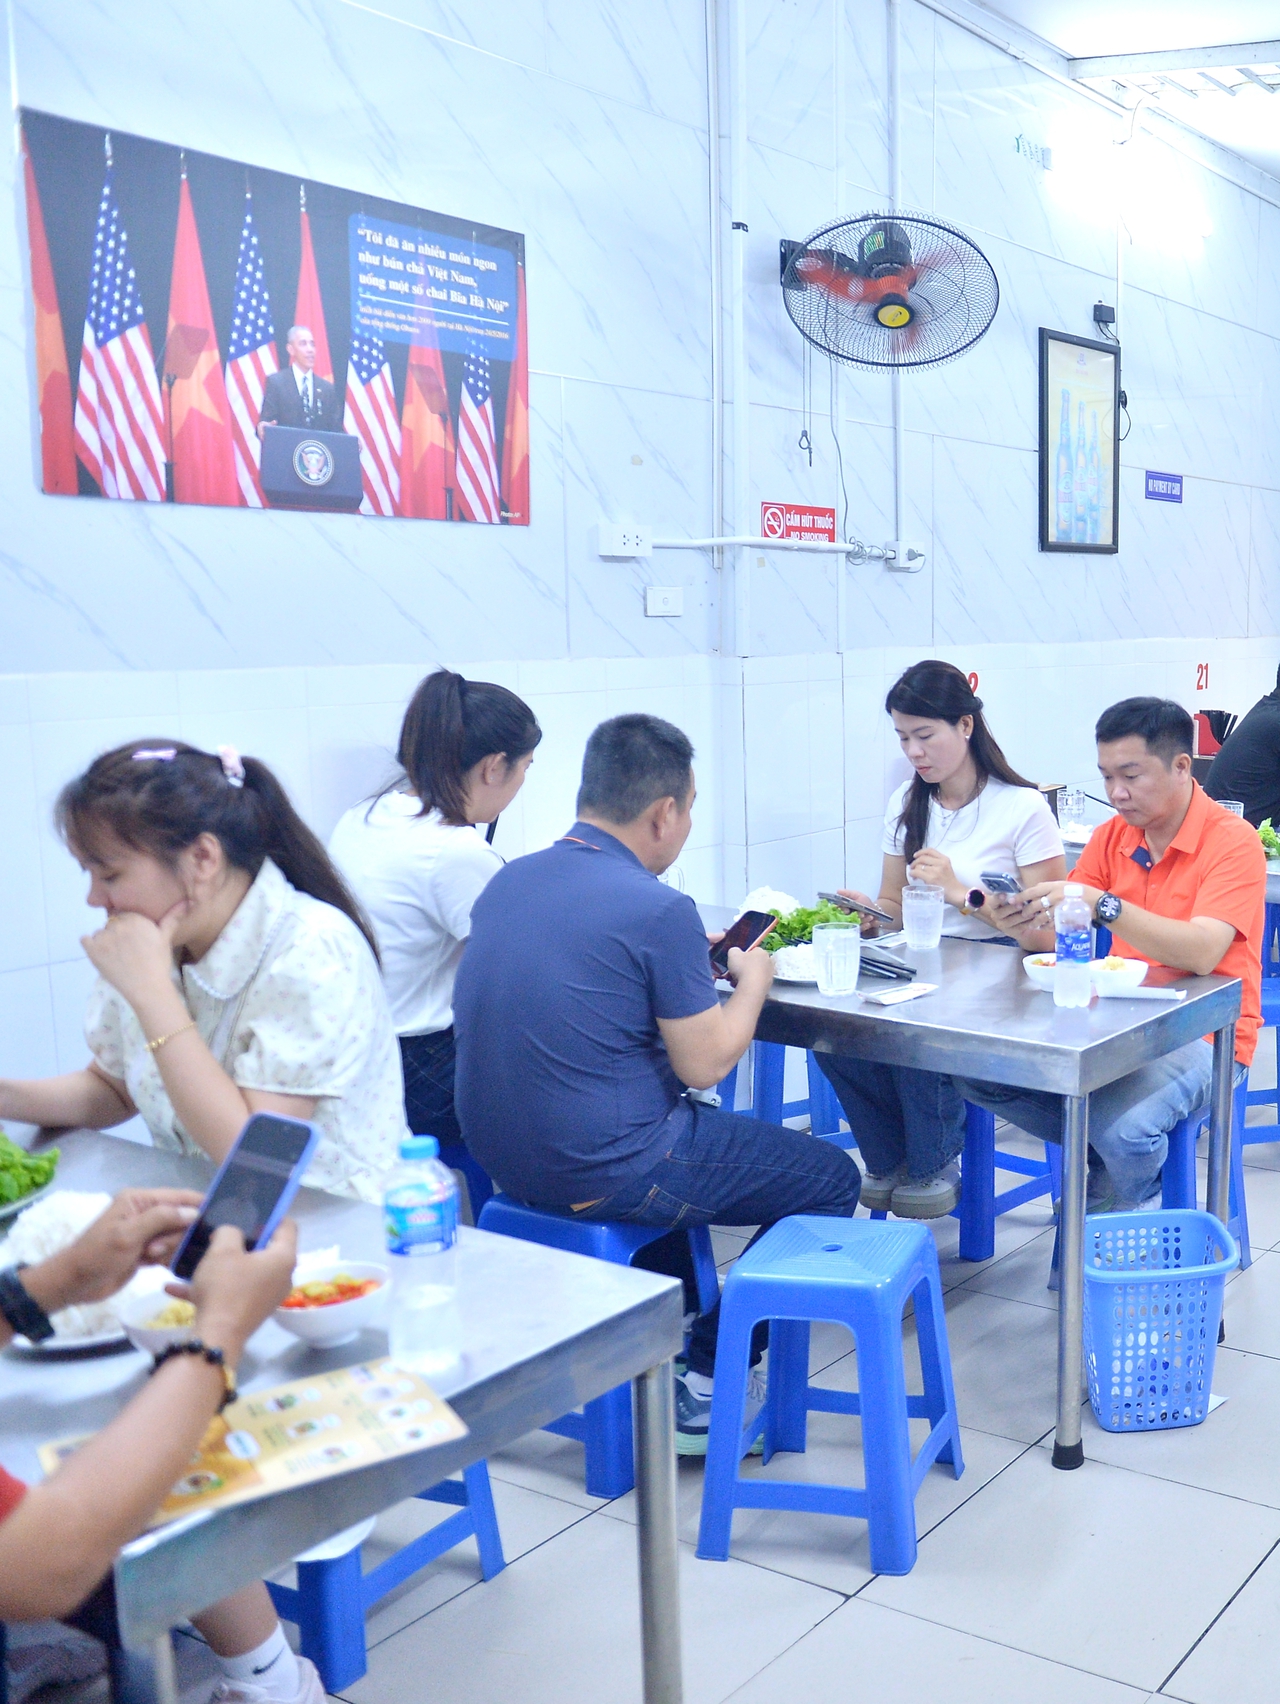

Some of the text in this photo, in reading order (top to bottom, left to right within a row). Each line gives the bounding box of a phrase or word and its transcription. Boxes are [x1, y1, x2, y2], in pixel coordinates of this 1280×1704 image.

[358, 250, 478, 288] như bún chả Việt Nam,
[385, 234, 400, 249] đã
[473, 255, 498, 272] ngon
[358, 272, 387, 291] uống
[388, 279, 410, 294] một
[411, 283, 424, 296] số
[426, 286, 448, 301] chai
[469, 294, 485, 309] Hà
[786, 510, 834, 530] CẤM HÚT THUỐC
[1196, 662, 1208, 690] 21
